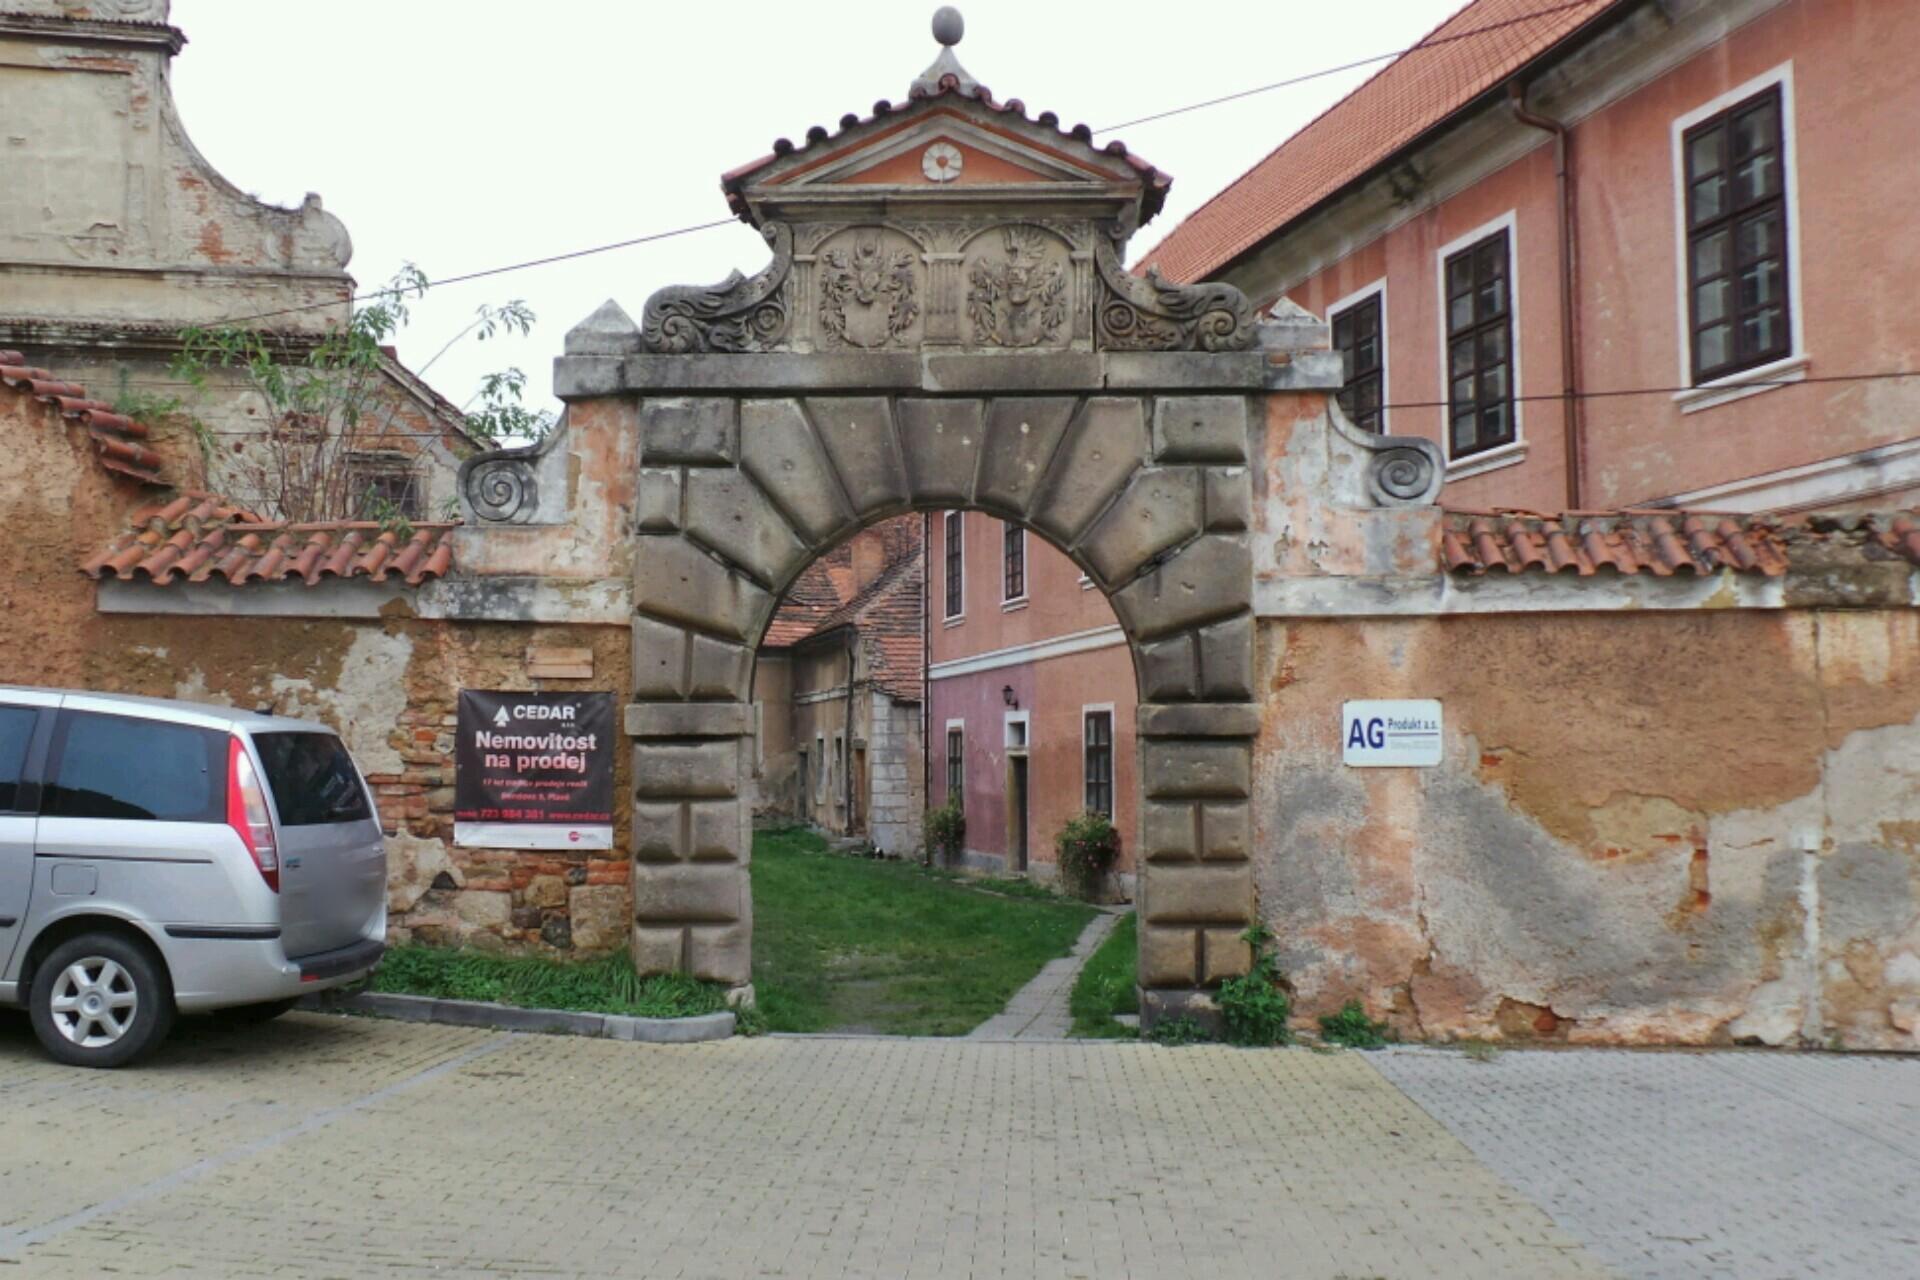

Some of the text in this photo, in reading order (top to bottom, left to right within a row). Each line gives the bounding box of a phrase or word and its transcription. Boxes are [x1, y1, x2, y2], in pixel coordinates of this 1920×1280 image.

[513, 704, 576, 720] CEDAR
[475, 730, 597, 750] Nemovitost
[1348, 717, 1384, 749] AG
[1388, 717, 1421, 729] Produkt
[485, 752, 586, 773] na prodej
